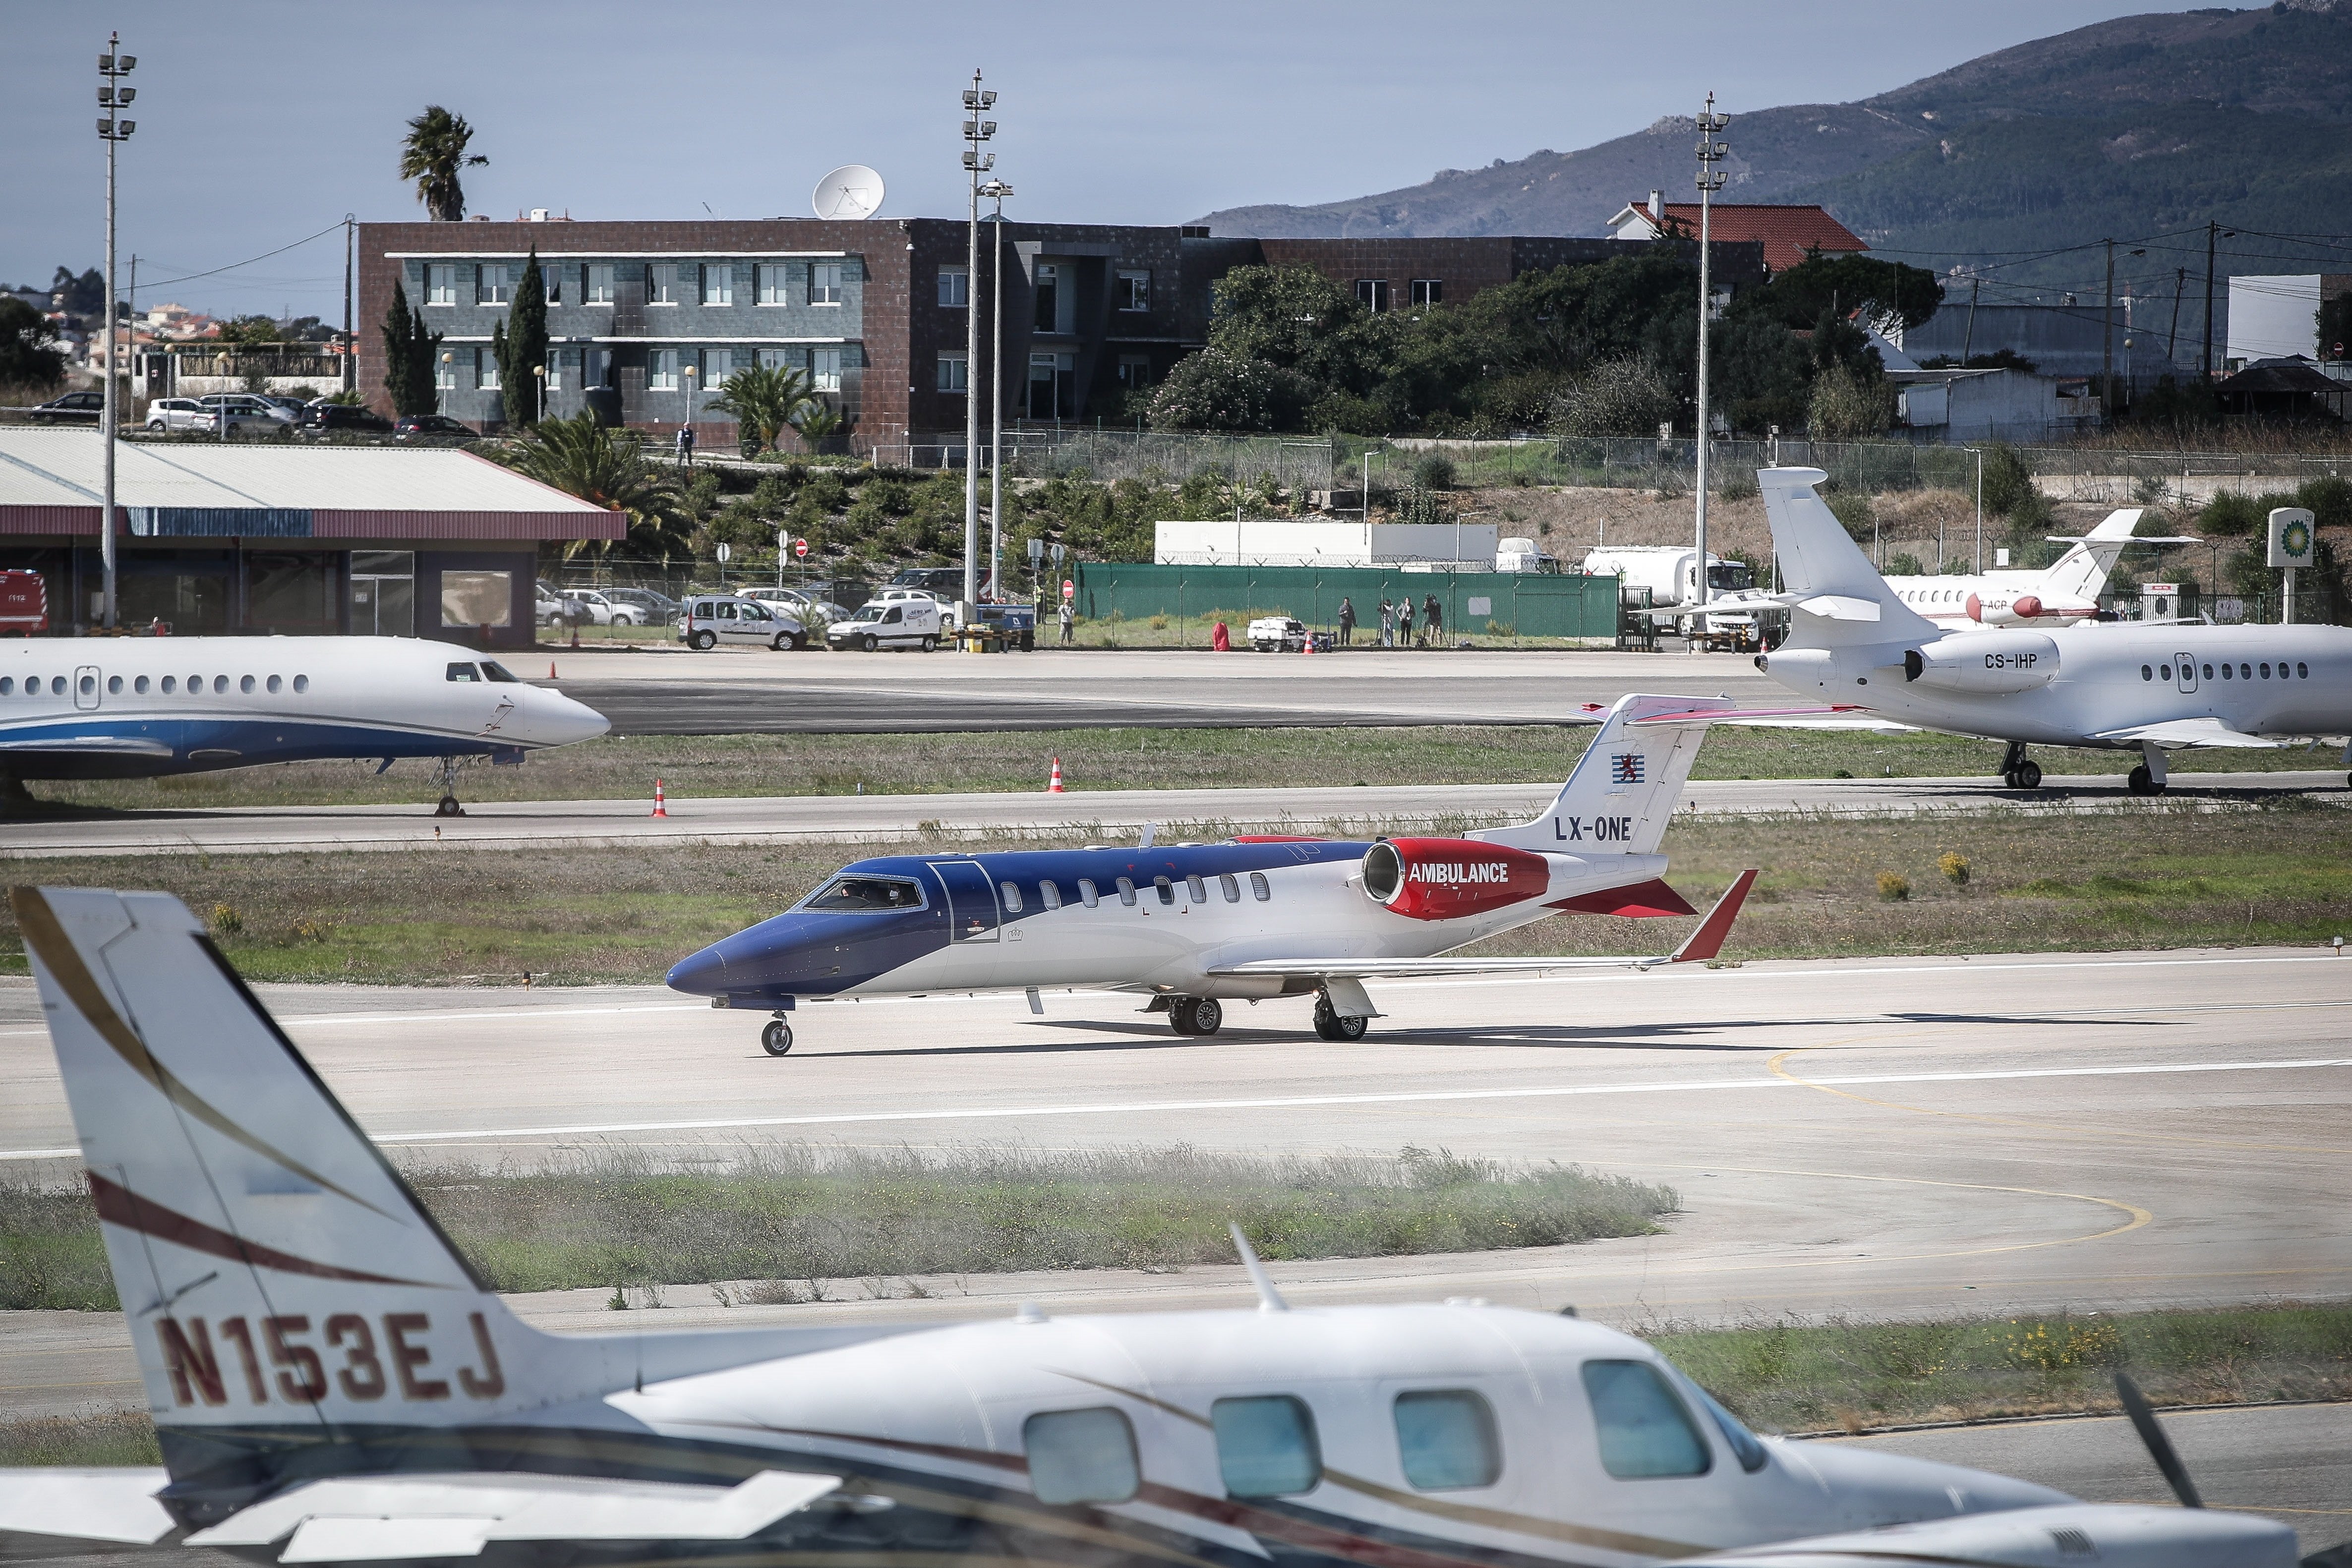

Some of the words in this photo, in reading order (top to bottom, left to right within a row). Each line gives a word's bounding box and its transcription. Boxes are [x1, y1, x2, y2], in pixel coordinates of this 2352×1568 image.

[1985, 654, 2037, 669] CS-IHP
[1554, 816, 1632, 841] LX-ONE
[1408, 863, 1509, 883] AMBULANCE
[154, 1312, 506, 1408] N153EJ
